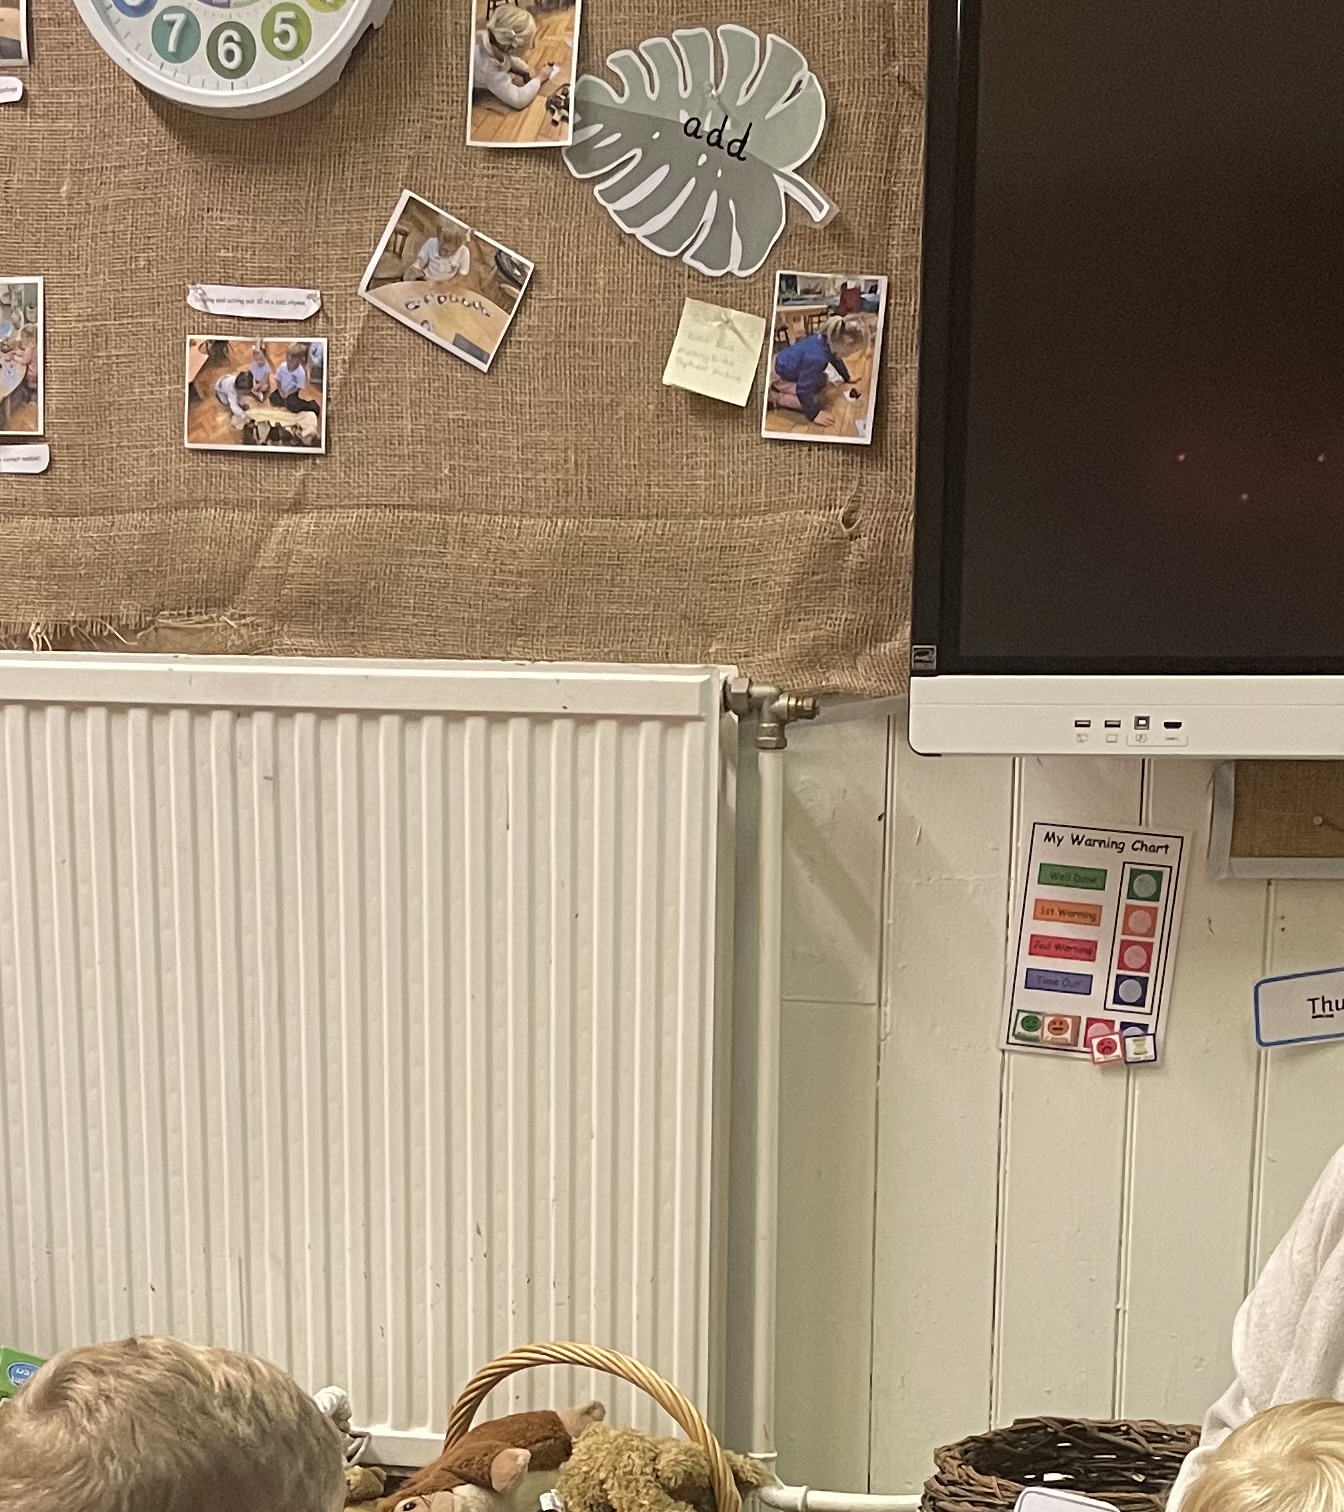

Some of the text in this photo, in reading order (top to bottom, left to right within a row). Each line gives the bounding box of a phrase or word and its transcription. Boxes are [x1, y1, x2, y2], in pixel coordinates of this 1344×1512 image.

[163, 11, 299, 70] 7 6 5
[684, 114, 752, 161] add
[1044, 831, 1170, 854] My Warning Chart
[1050, 870, 1098, 884] Well Done
[1040, 905, 1097, 922] 1st Warning
[1054, 942, 1094, 957] Warning
[1036, 975, 1082, 988] Time Out
